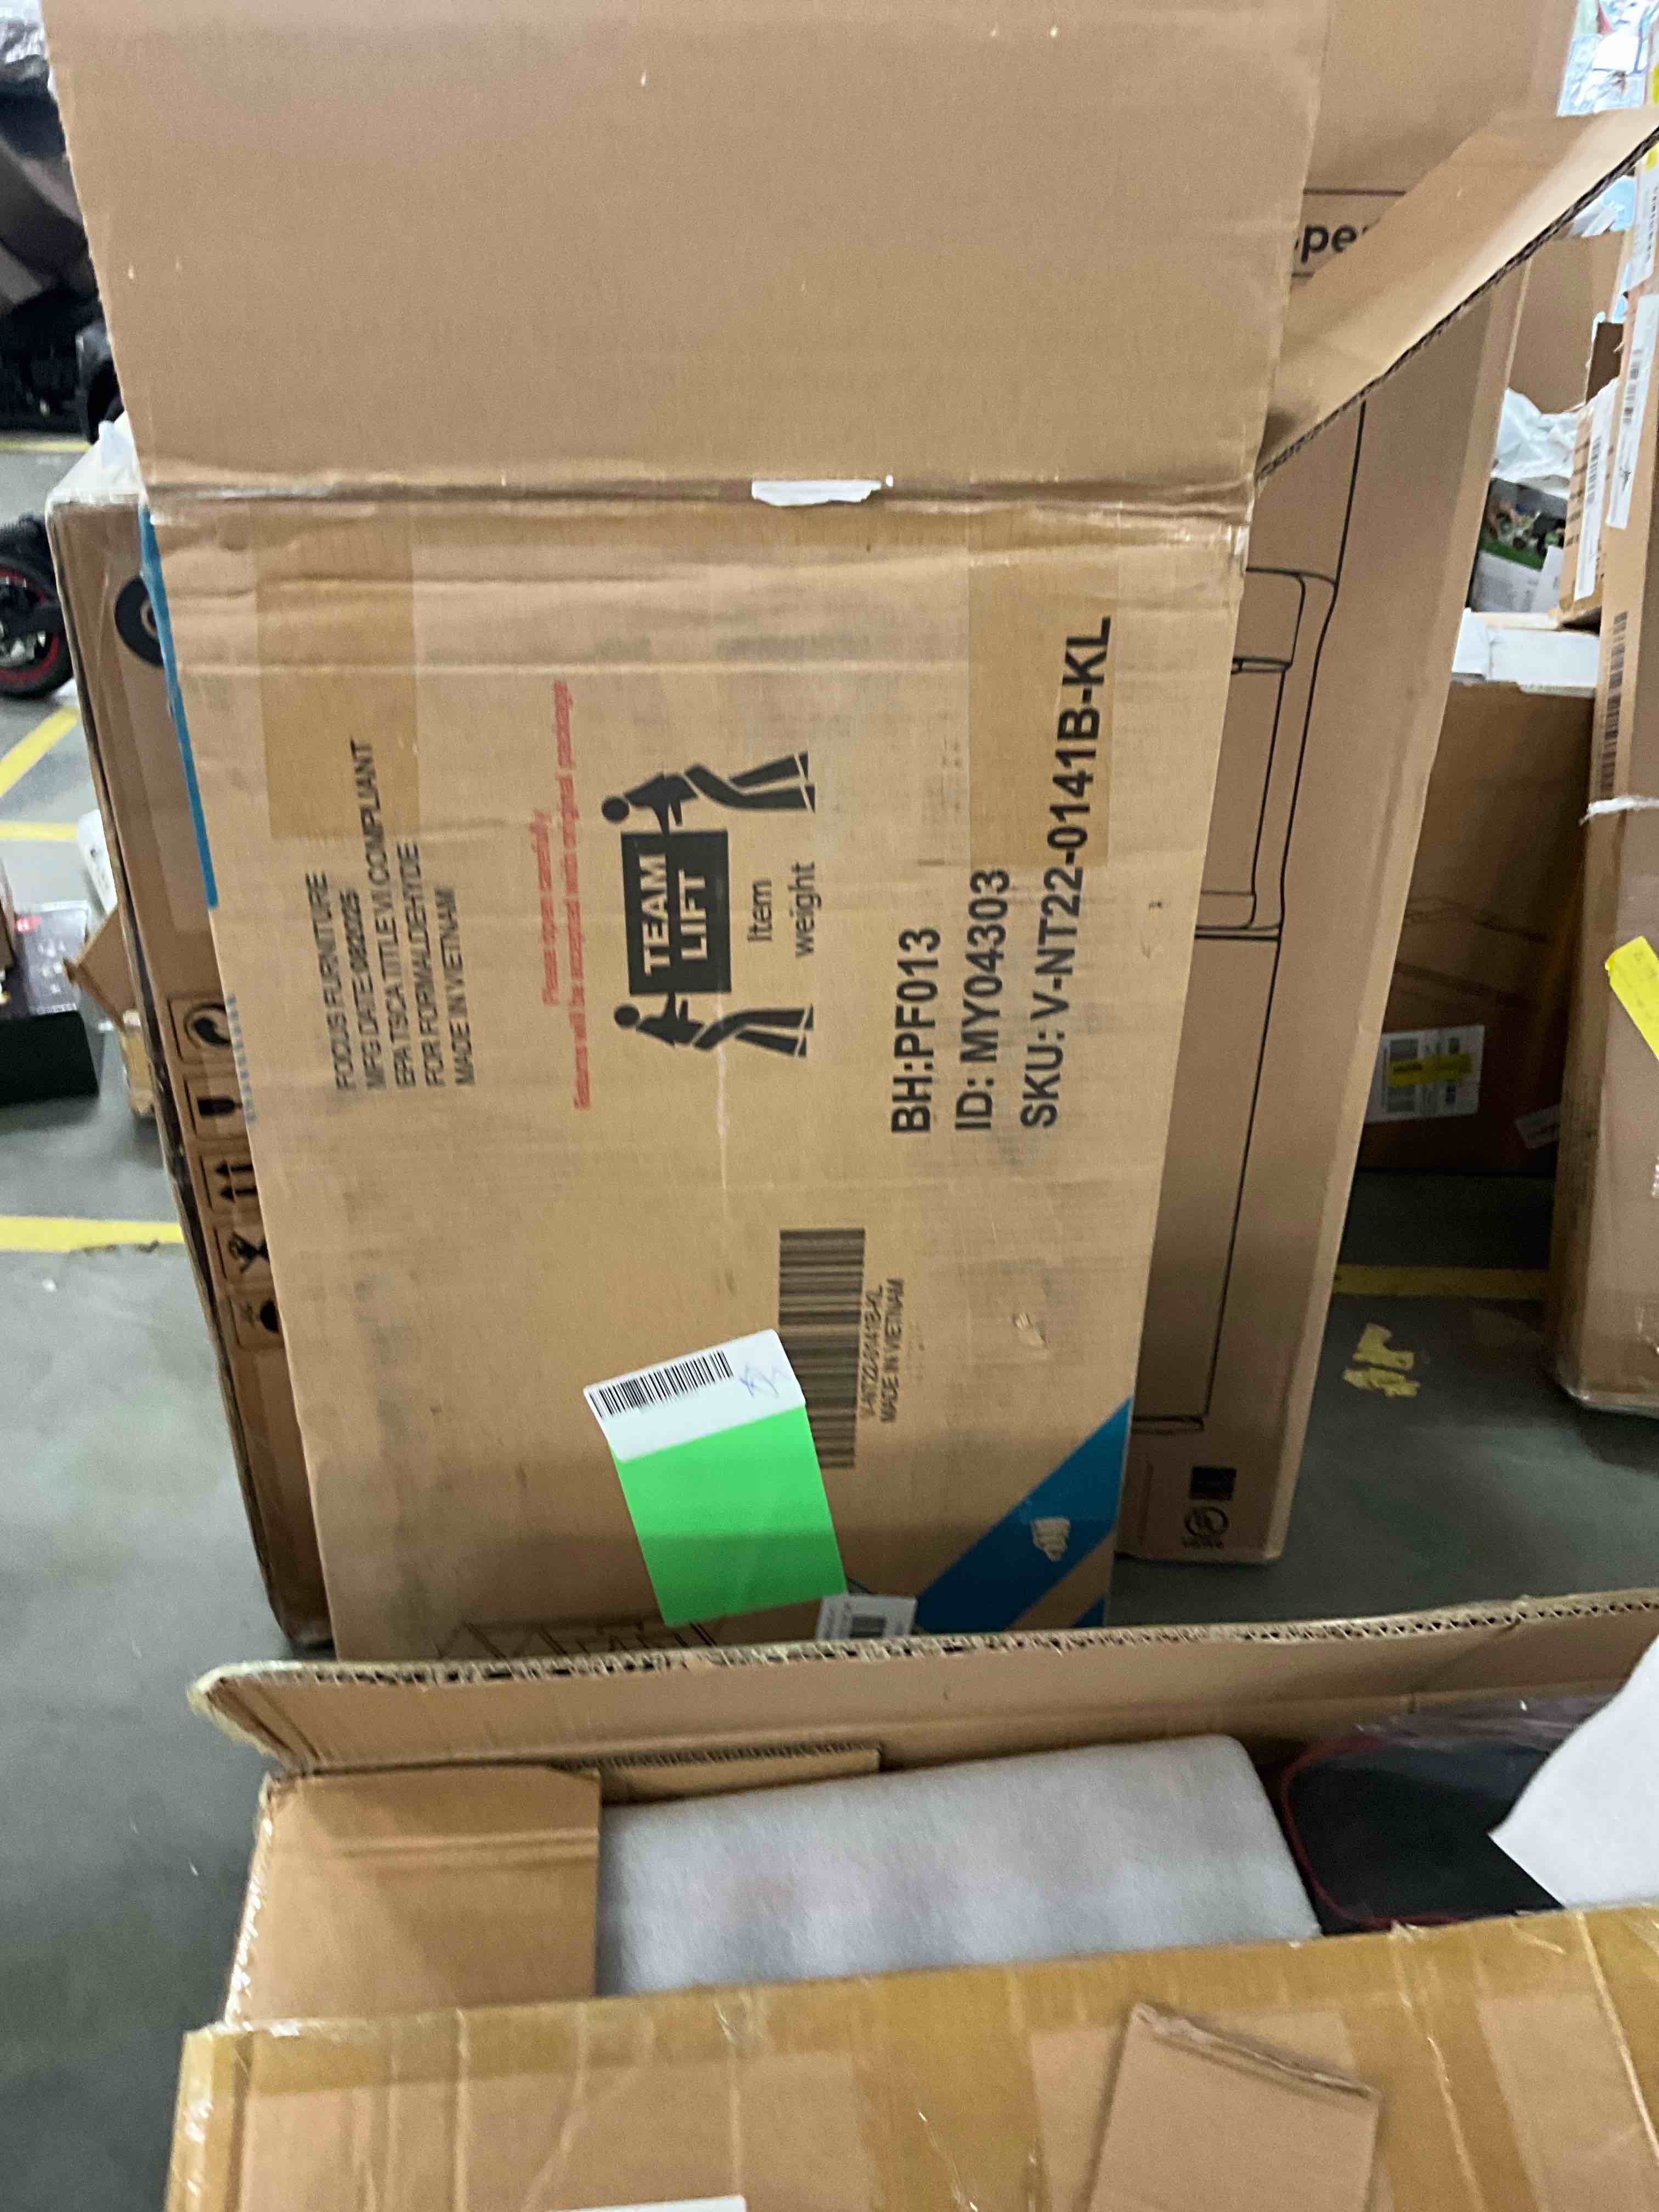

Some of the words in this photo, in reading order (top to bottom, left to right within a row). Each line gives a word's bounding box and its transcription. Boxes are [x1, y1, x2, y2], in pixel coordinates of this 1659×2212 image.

[349, 738, 390, 885] COMPLIANT
[1029, 616, 1110, 1021] V-NT22-0141B-KL
[305, 873, 341, 1007] FURNITURE
[375, 917, 402, 983] TITLE
[397, 843, 438, 1036] FORMALDEHYDE
[434, 887, 464, 995] VIETNAM
[639, 854, 672, 975] TEAM
[678, 868, 708, 961] LIFT
[747, 879, 774, 943] Item
[788, 861, 822, 958] weight
[384, 983, 411, 1043] TSCA
[446, 995, 467, 1018] IN
[961, 869, 1009, 1063] MY04303
[326, 1012, 356, 1089] FOCUS
[421, 1040, 445, 1087] FOR
[449, 1022, 475, 1085] MADE
[890, 927, 940, 1134] BH:PF013
[1019, 1029, 1064, 1128] SKU:
[955, 1077, 995, 1131] ID:
